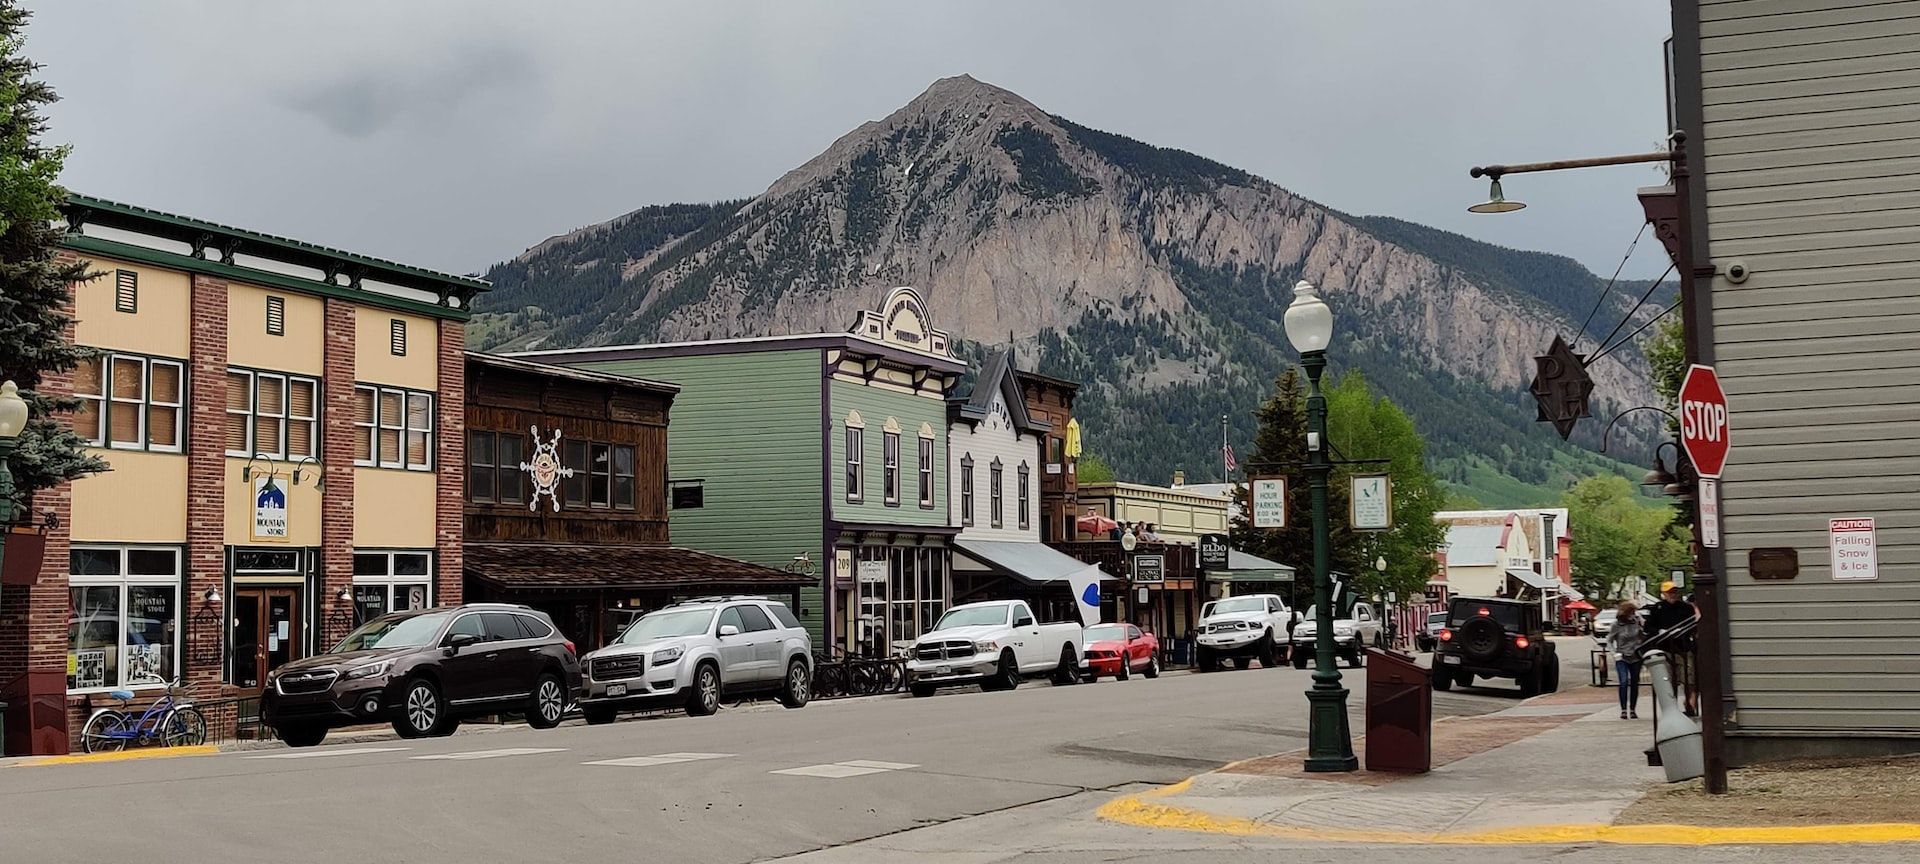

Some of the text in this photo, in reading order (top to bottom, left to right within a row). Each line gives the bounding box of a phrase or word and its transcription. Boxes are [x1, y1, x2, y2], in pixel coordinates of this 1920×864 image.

[1684, 400, 1726, 442] STOP
[1255, 501, 1282, 509] PARKING
[257, 516, 285, 527] MOUNTAIN
[1831, 520, 1873, 529] CAUTION!
[267, 528, 284, 536] STORE
[1835, 536, 1871, 546] Falling
[1202, 544, 1227, 552] ELDO
[1839, 550, 1869, 558] Snow
[837, 558, 850, 570] 209
[1852, 562, 1868, 570] Ice
[134, 595, 166, 606] MOUNTAIN
